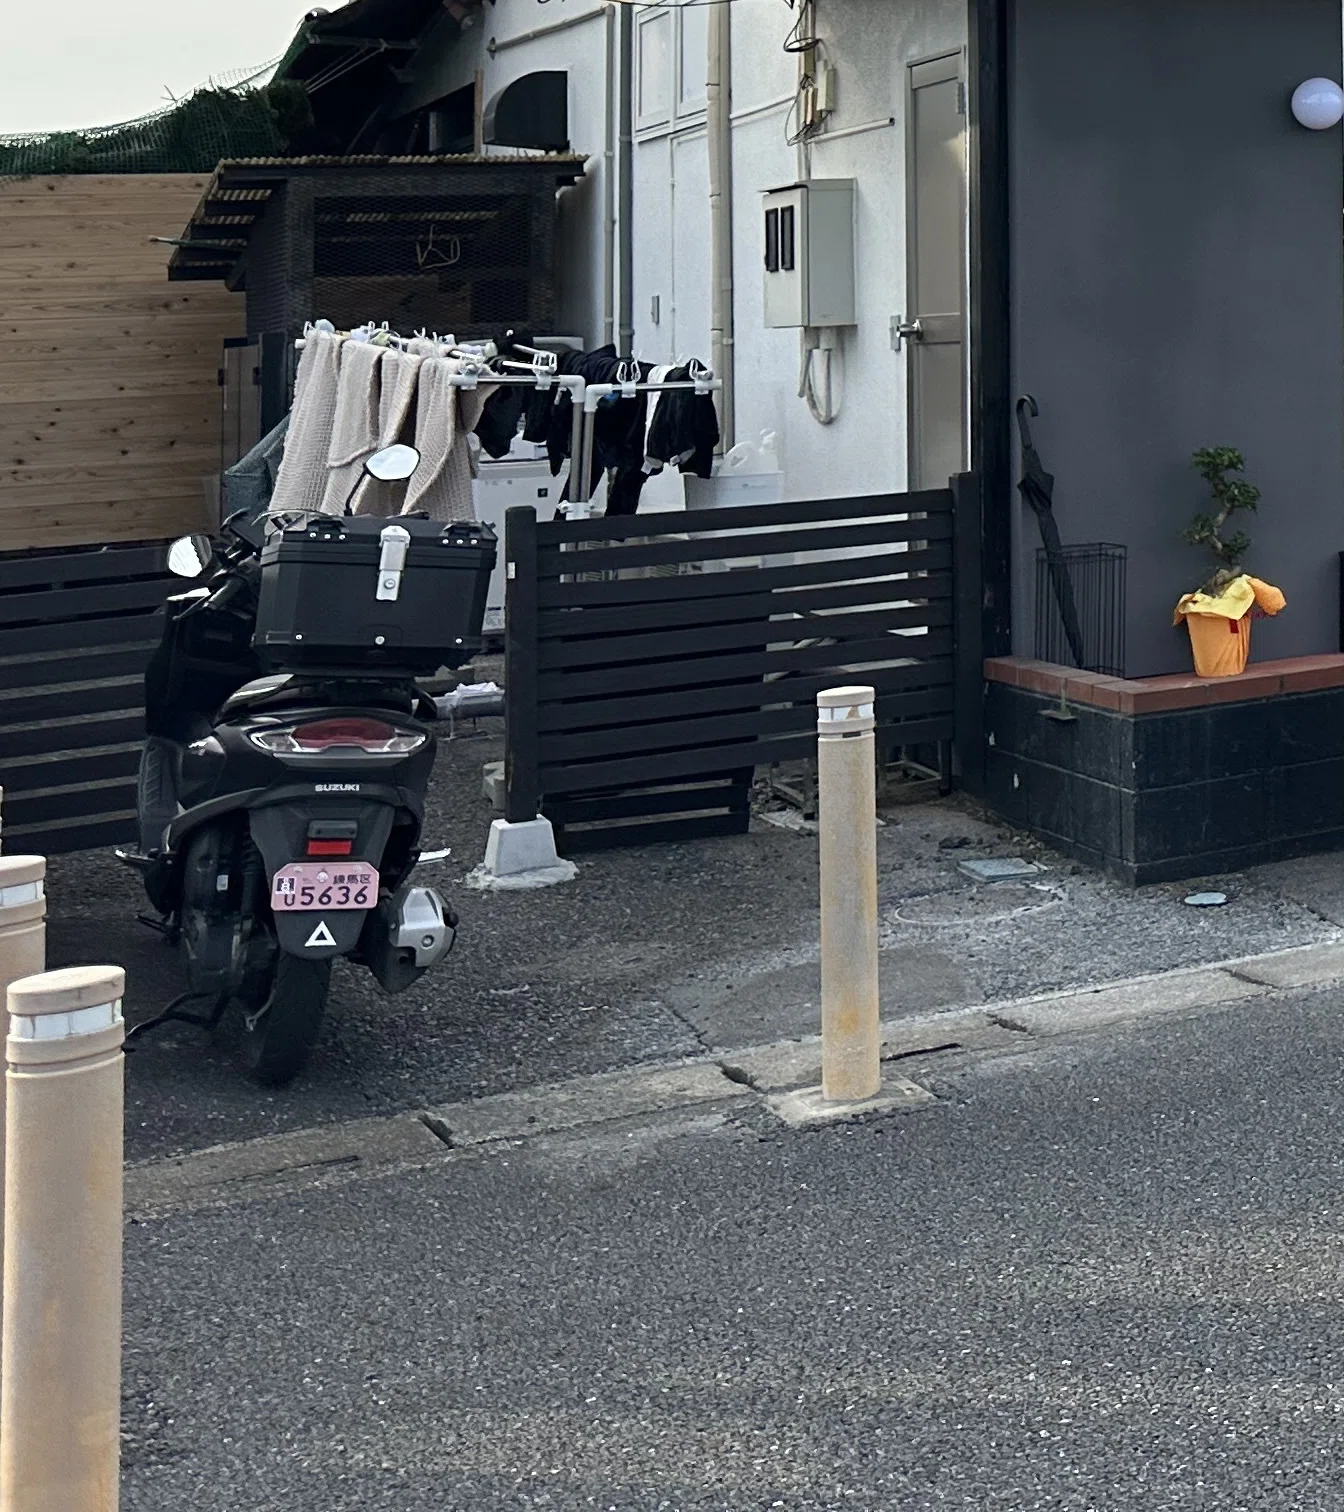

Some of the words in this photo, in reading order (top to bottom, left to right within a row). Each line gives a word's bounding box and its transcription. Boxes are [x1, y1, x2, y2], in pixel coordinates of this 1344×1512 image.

[314, 784, 360, 792] SUZUKI
[332, 873, 372, 885] 練馬区
[300, 885, 369, 906] 5636
